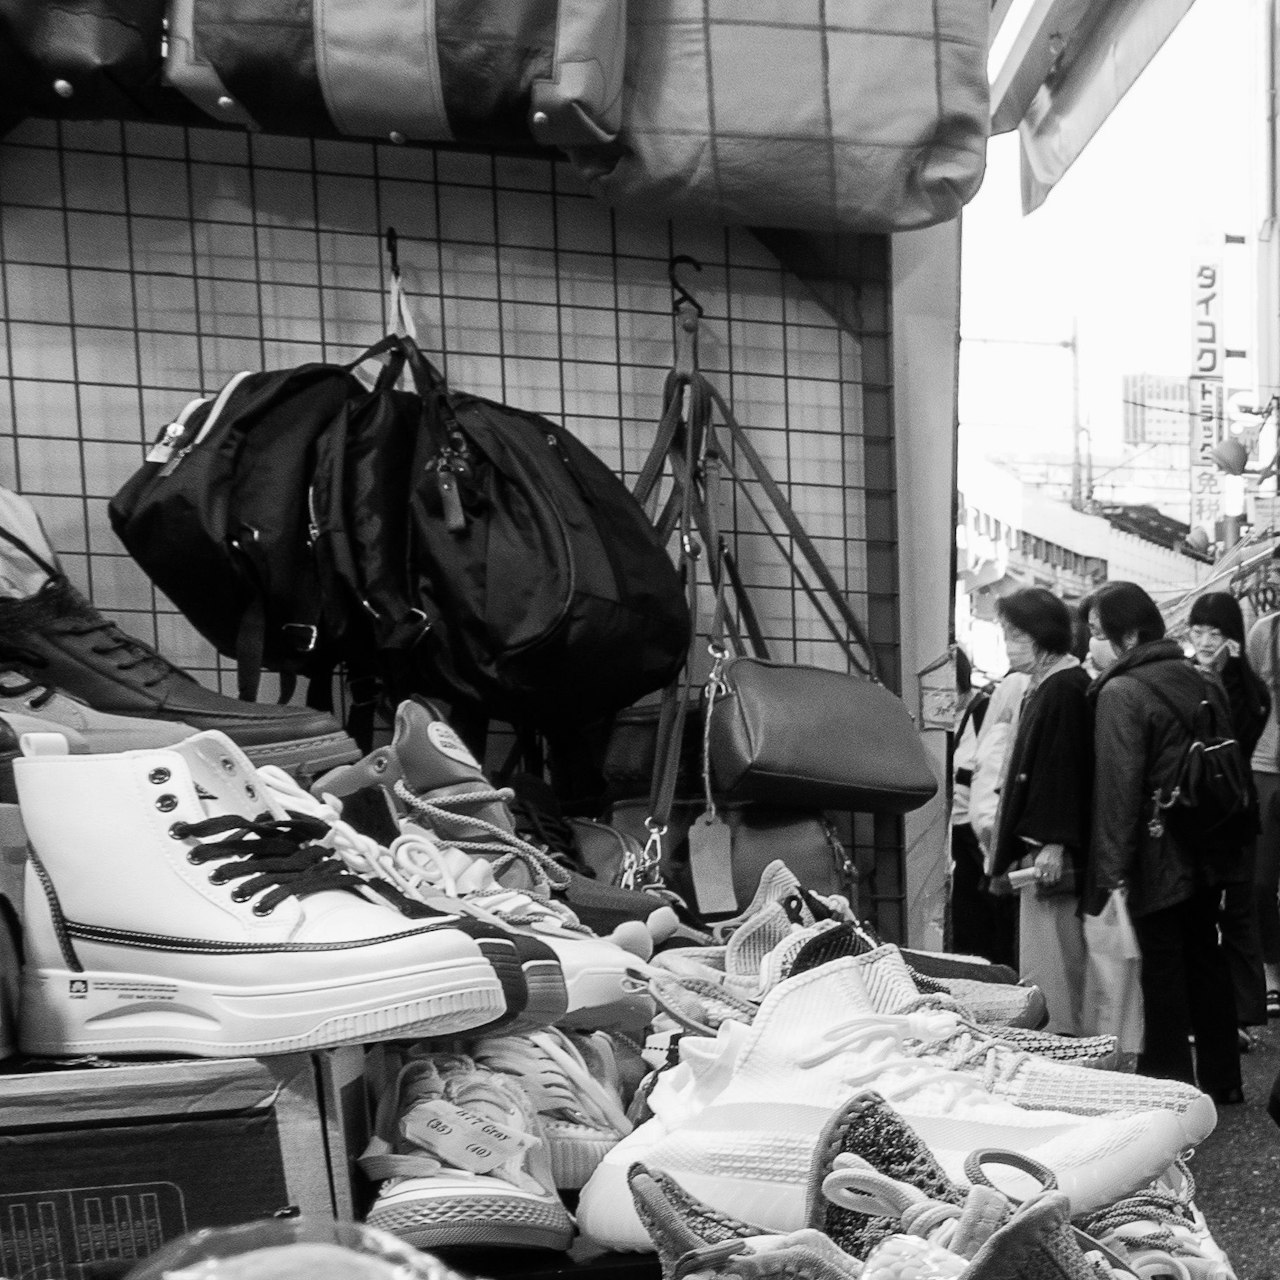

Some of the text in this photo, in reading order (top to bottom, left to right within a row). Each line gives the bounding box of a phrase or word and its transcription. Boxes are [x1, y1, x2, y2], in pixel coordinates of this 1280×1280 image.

[1195, 471, 1221, 521] 免税
[426, 1118, 493, 1159] (35) (40)
[482, 1124, 513, 1142] Gray
